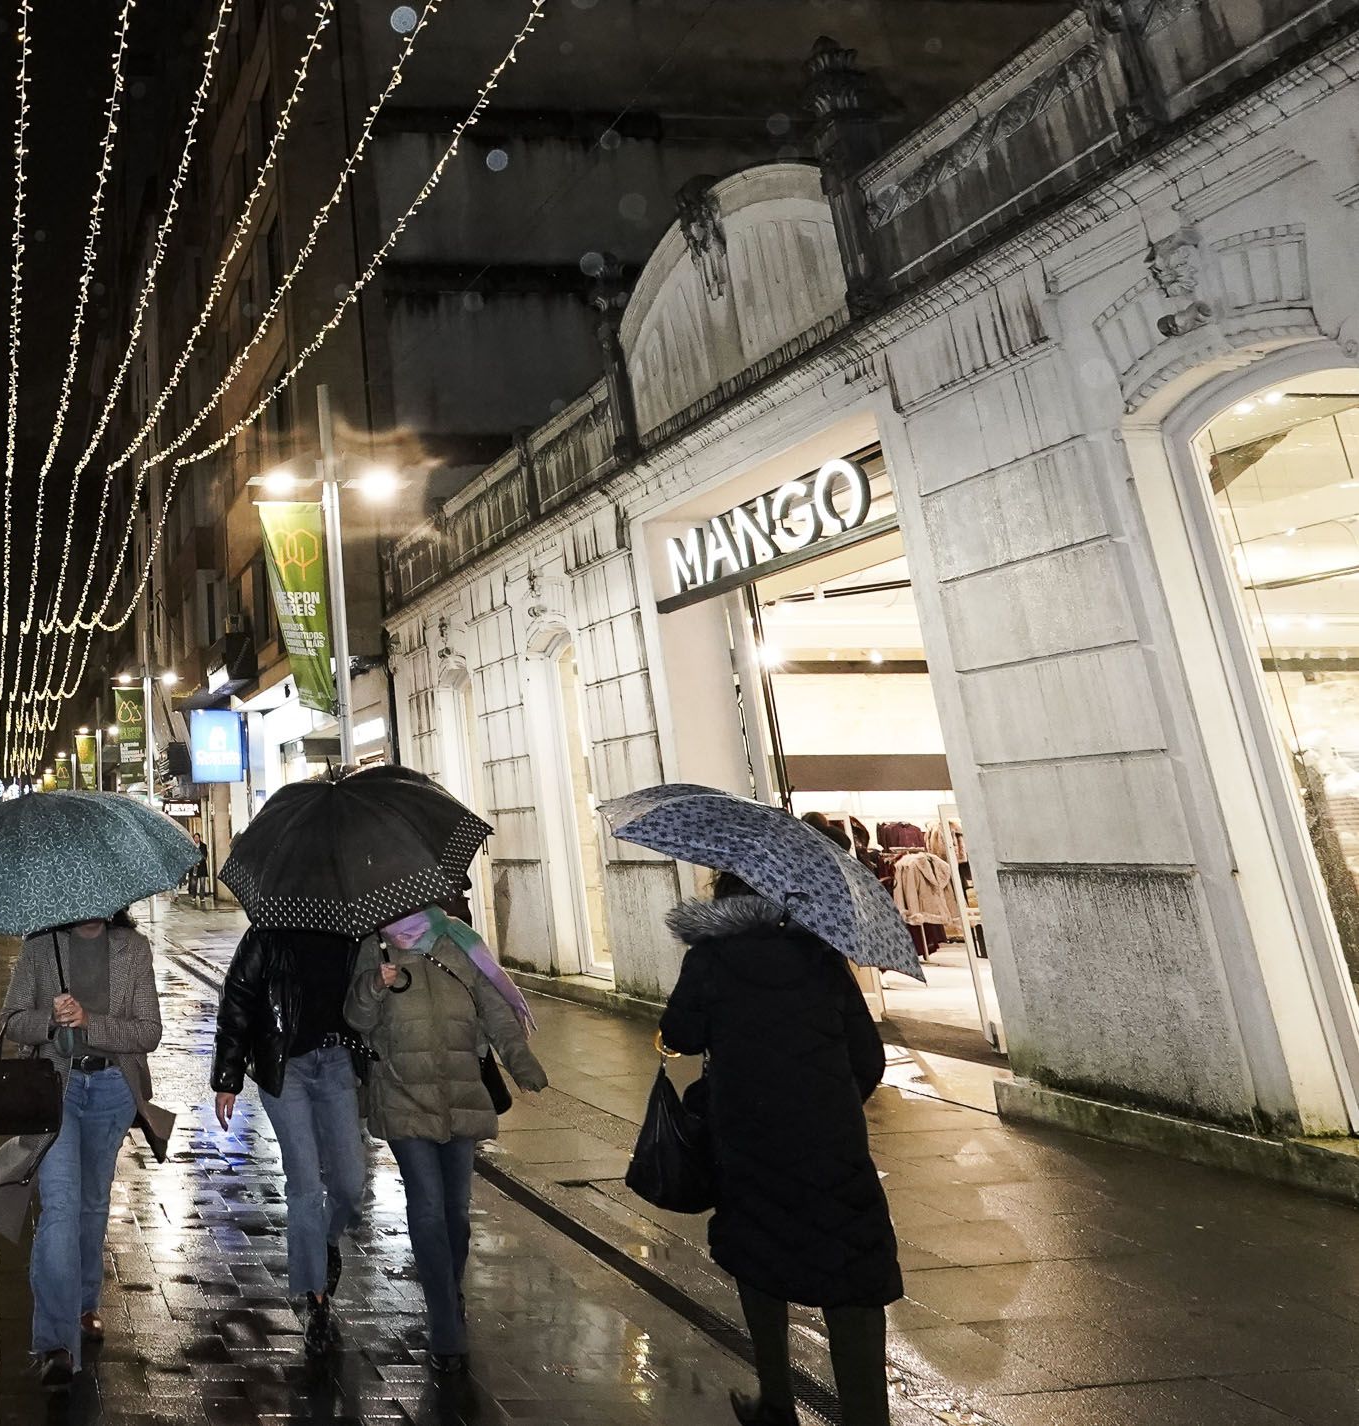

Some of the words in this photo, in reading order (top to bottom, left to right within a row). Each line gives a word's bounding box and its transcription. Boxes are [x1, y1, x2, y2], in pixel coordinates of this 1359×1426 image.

[666, 458, 869, 594] MANGO
[275, 591, 321, 605] RESPON
[278, 603, 317, 617] SABEIS
